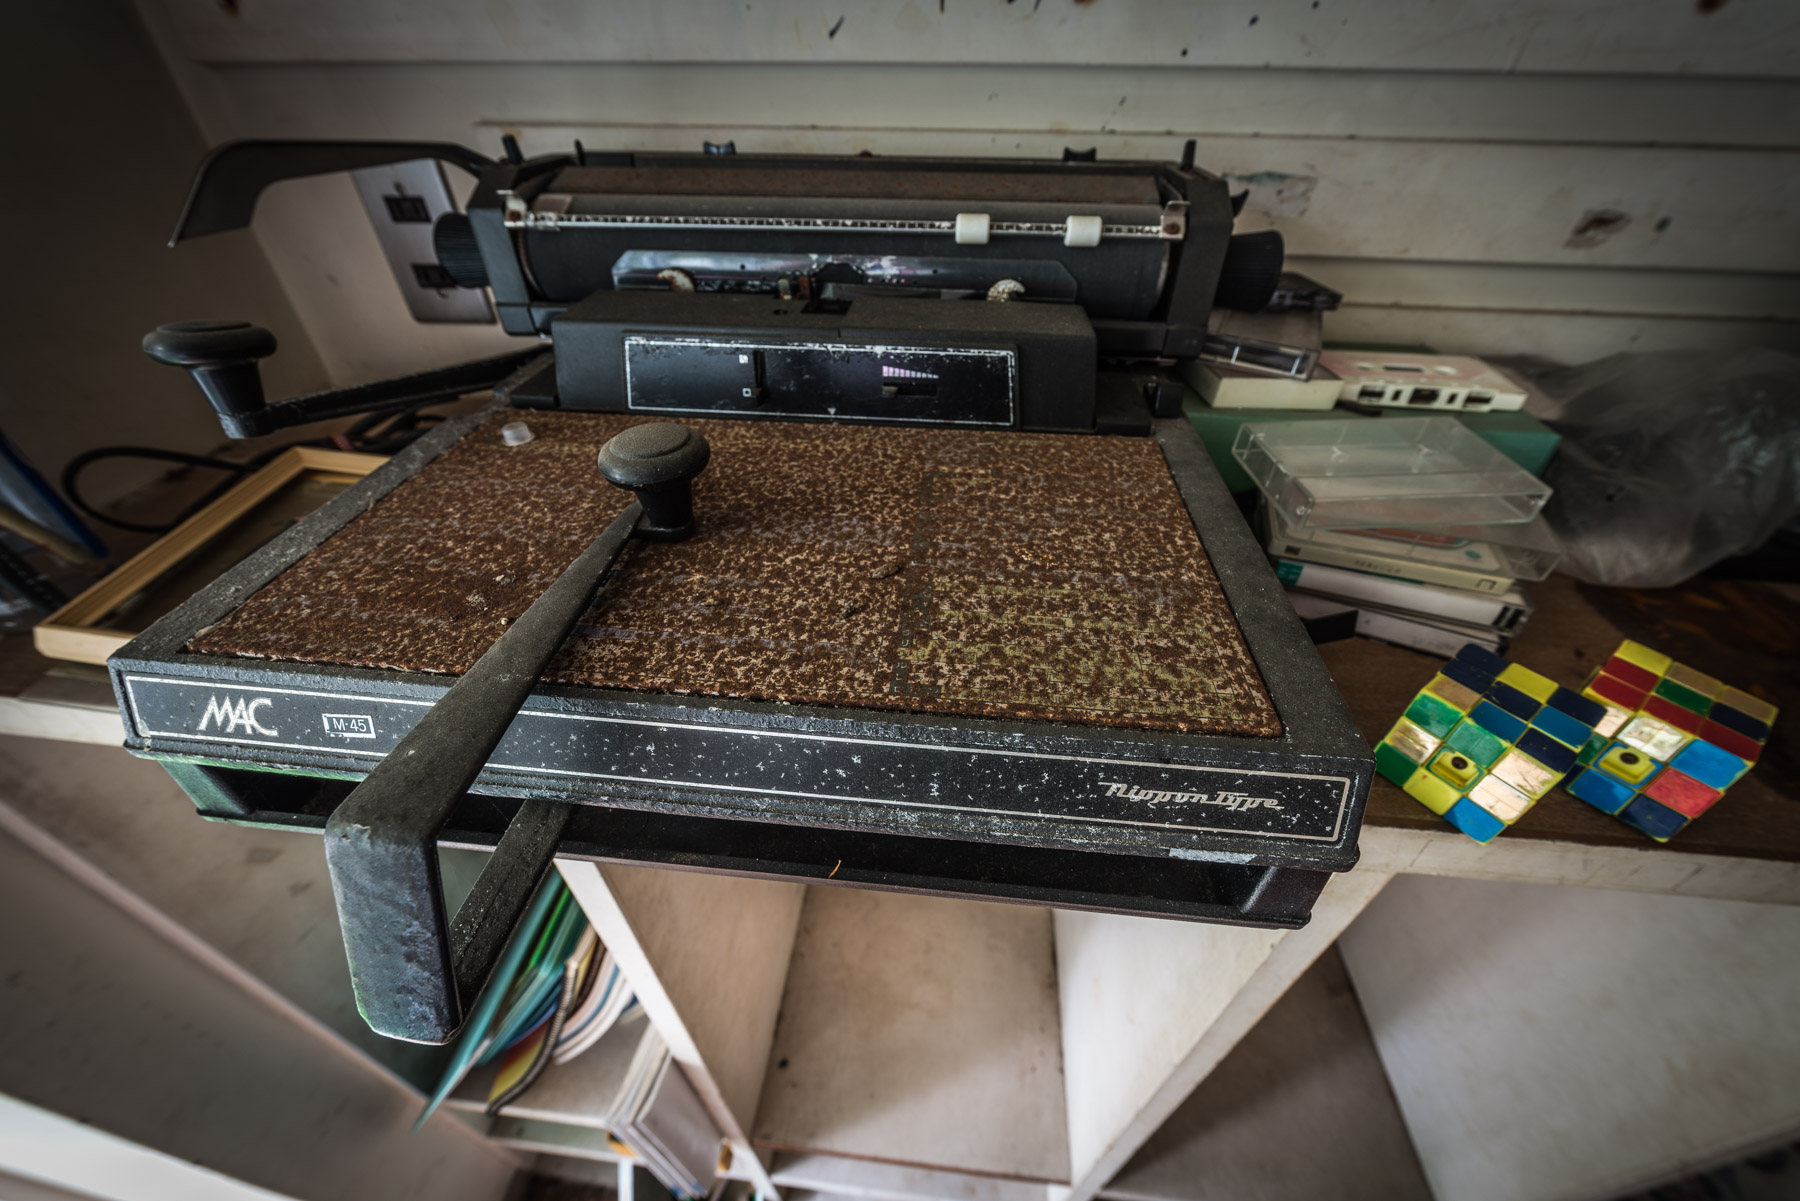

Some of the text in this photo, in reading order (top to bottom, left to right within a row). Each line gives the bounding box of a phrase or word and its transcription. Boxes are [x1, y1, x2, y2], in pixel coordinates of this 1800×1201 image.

[196, 693, 279, 737] MAC
[1098, 781, 1285, 811] Nippon Type
